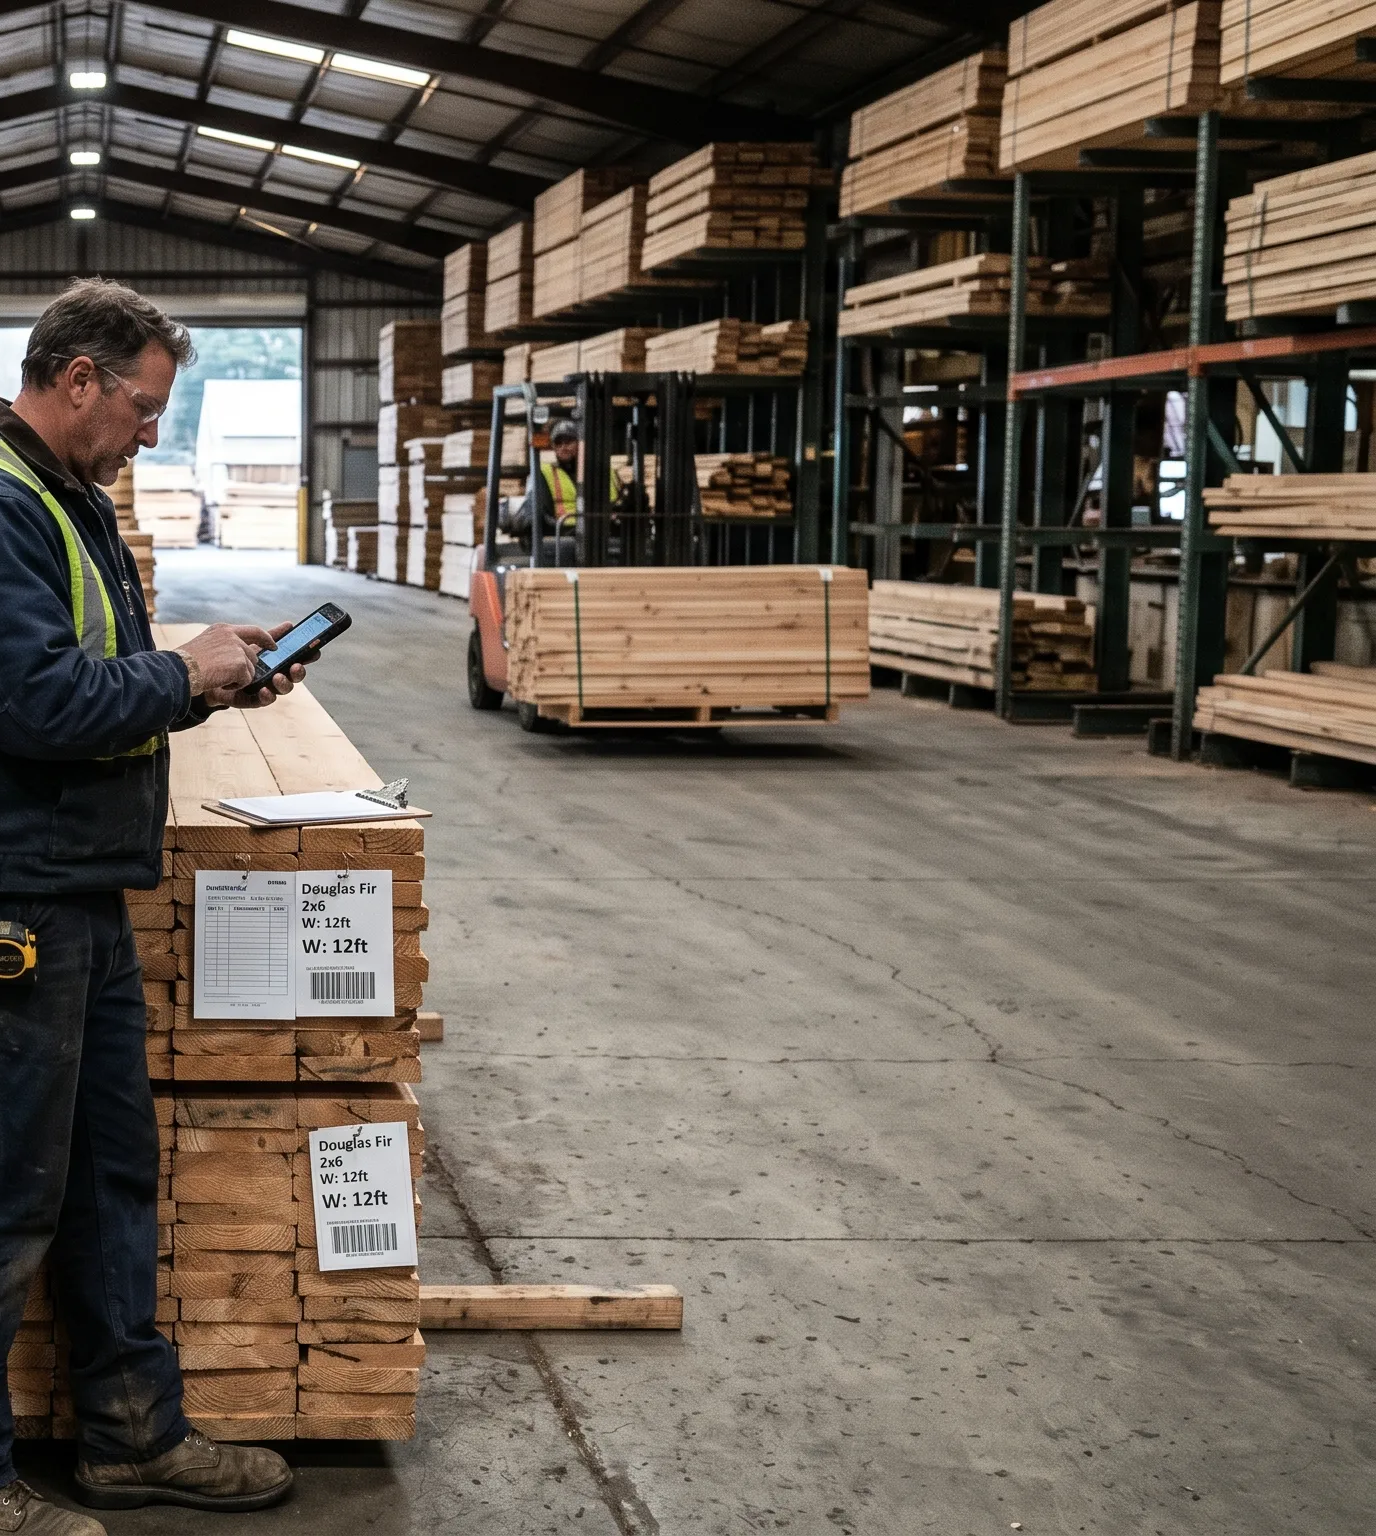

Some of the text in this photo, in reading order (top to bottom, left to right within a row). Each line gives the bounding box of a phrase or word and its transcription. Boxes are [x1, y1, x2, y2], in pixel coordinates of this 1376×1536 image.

[301, 882, 377, 897] Douglas Fir
[301, 900, 326, 912] 2x6
[301, 917, 351, 929] W: 12ft
[302, 938, 369, 954] W: 12ft
[319, 1135, 393, 1152] Douglas Fir
[320, 1156, 343, 1168] 2x6
[320, 1170, 369, 1185] W: 12ft
[322, 1190, 389, 1209] W: 12ft
